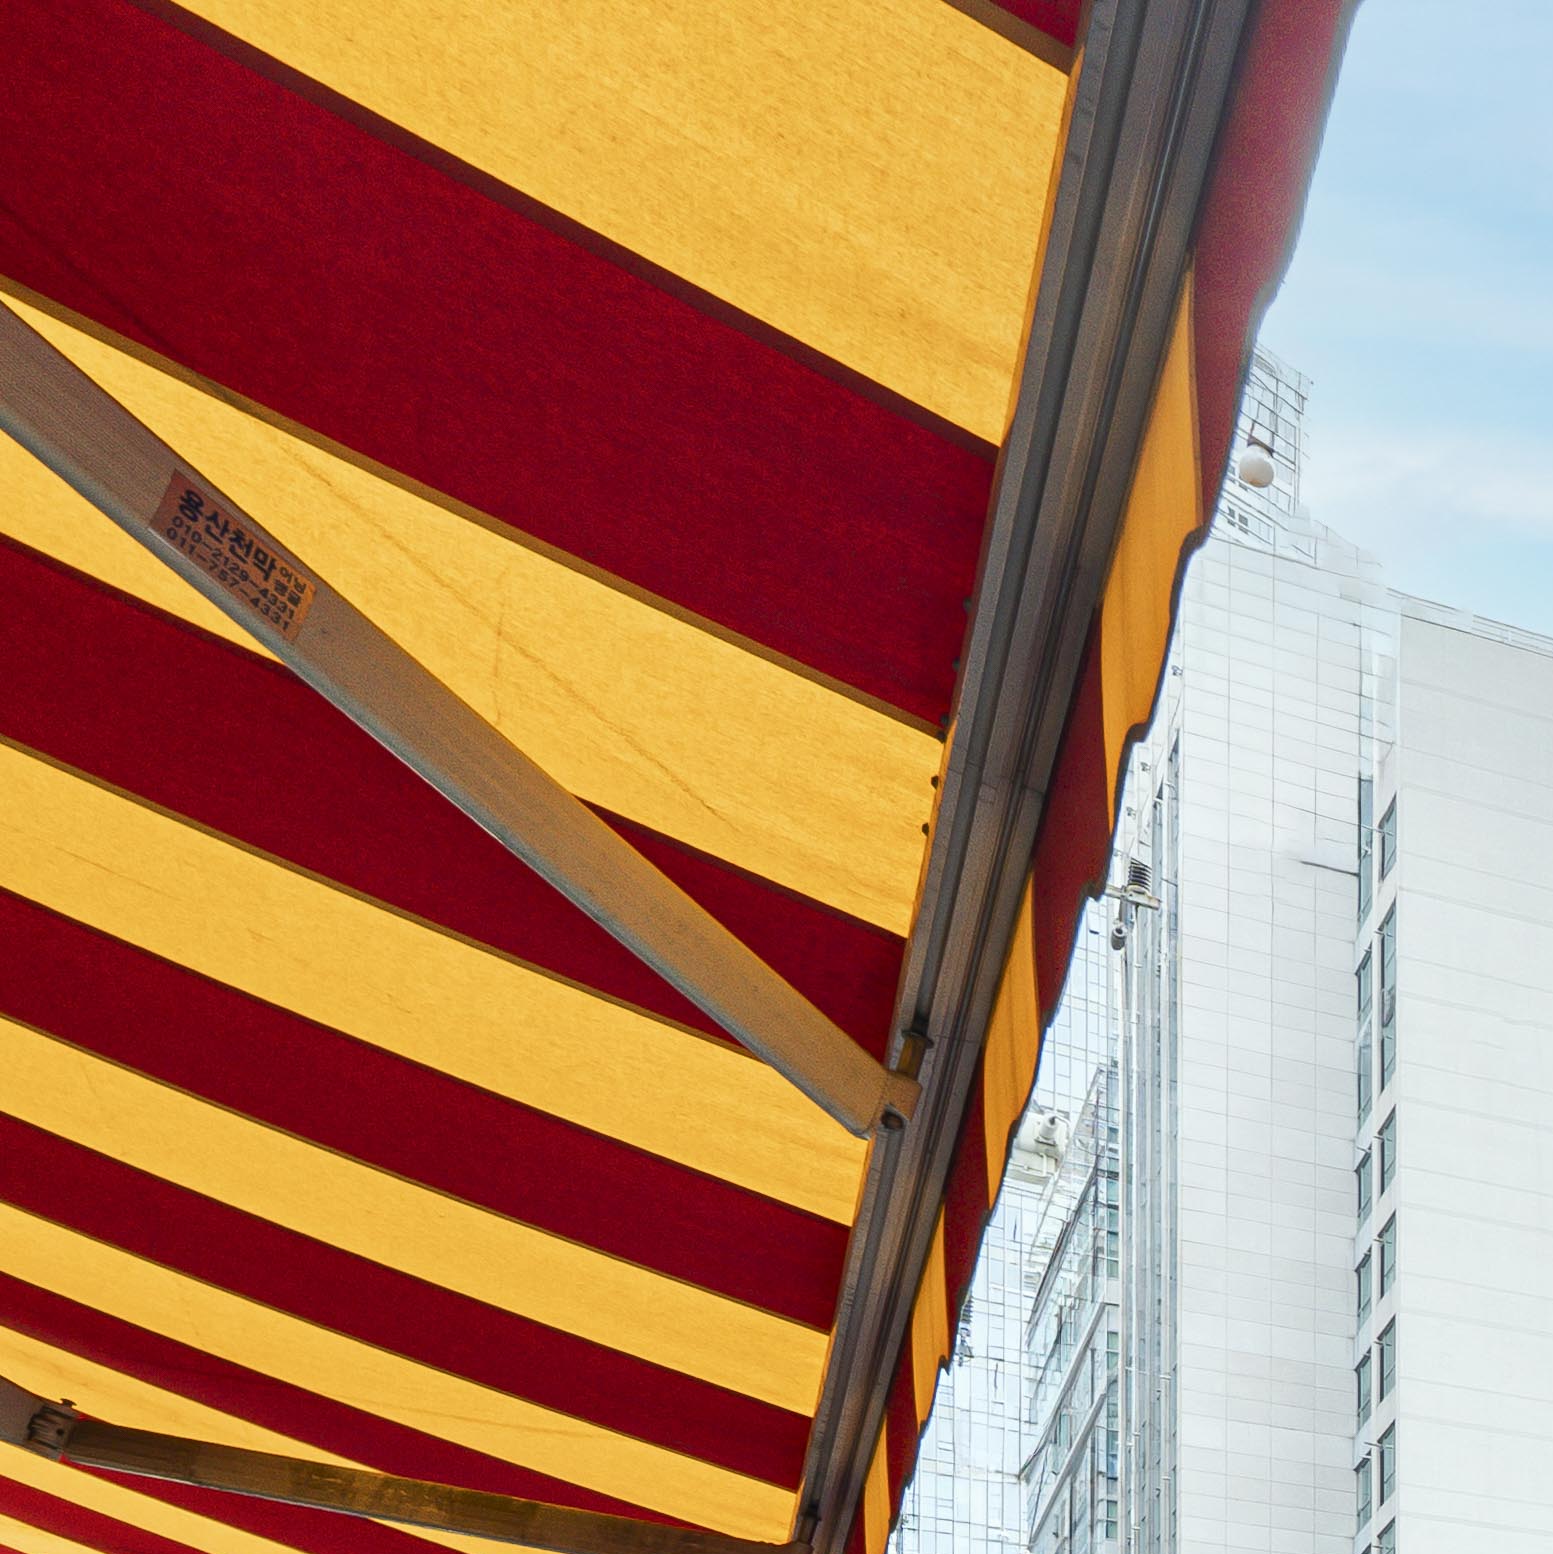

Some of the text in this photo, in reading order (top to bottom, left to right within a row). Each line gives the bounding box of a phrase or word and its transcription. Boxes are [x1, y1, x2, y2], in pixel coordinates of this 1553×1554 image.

[166, 526, 290, 631] 011-757-4331
[172, 515, 295, 620] 010-2129-4331
[177, 488, 277, 582] 용산천막
